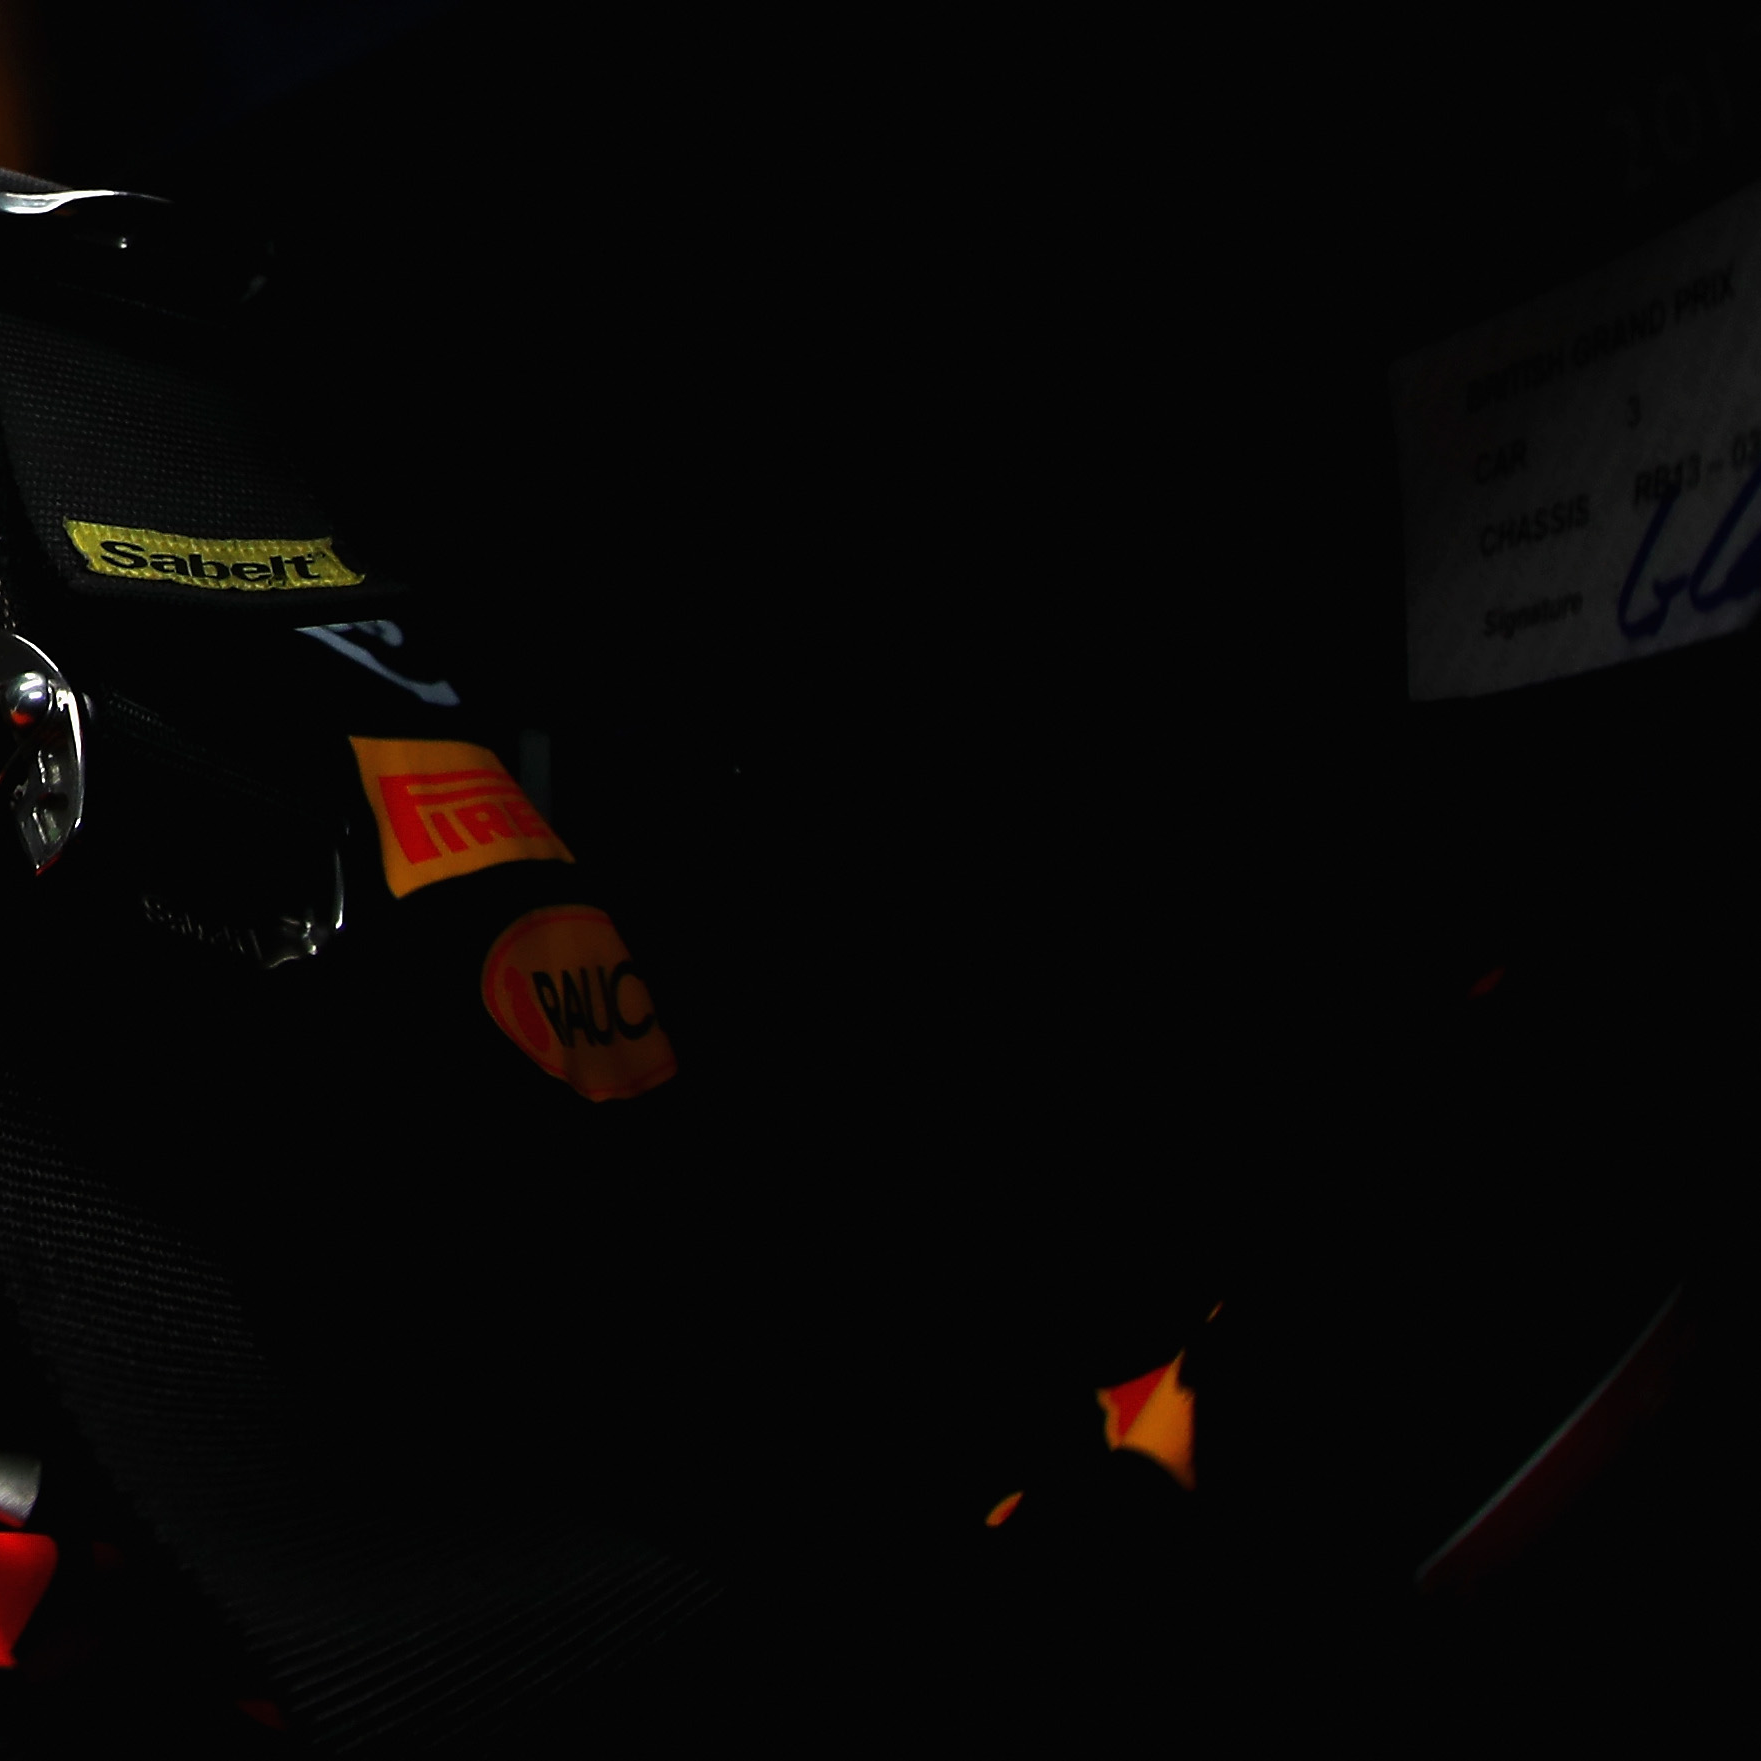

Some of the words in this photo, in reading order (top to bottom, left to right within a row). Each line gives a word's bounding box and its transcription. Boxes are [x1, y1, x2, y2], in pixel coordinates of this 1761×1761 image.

[1571, 298, 1667, 368] GRAND
[1674, 262, 1735, 325] PRIX
[1475, 438, 1528, 486] CAR
[1626, 394, 1641, 430] 3
[100, 541, 321, 582] Sabelt
[1479, 493, 1590, 558] CHASSIS
